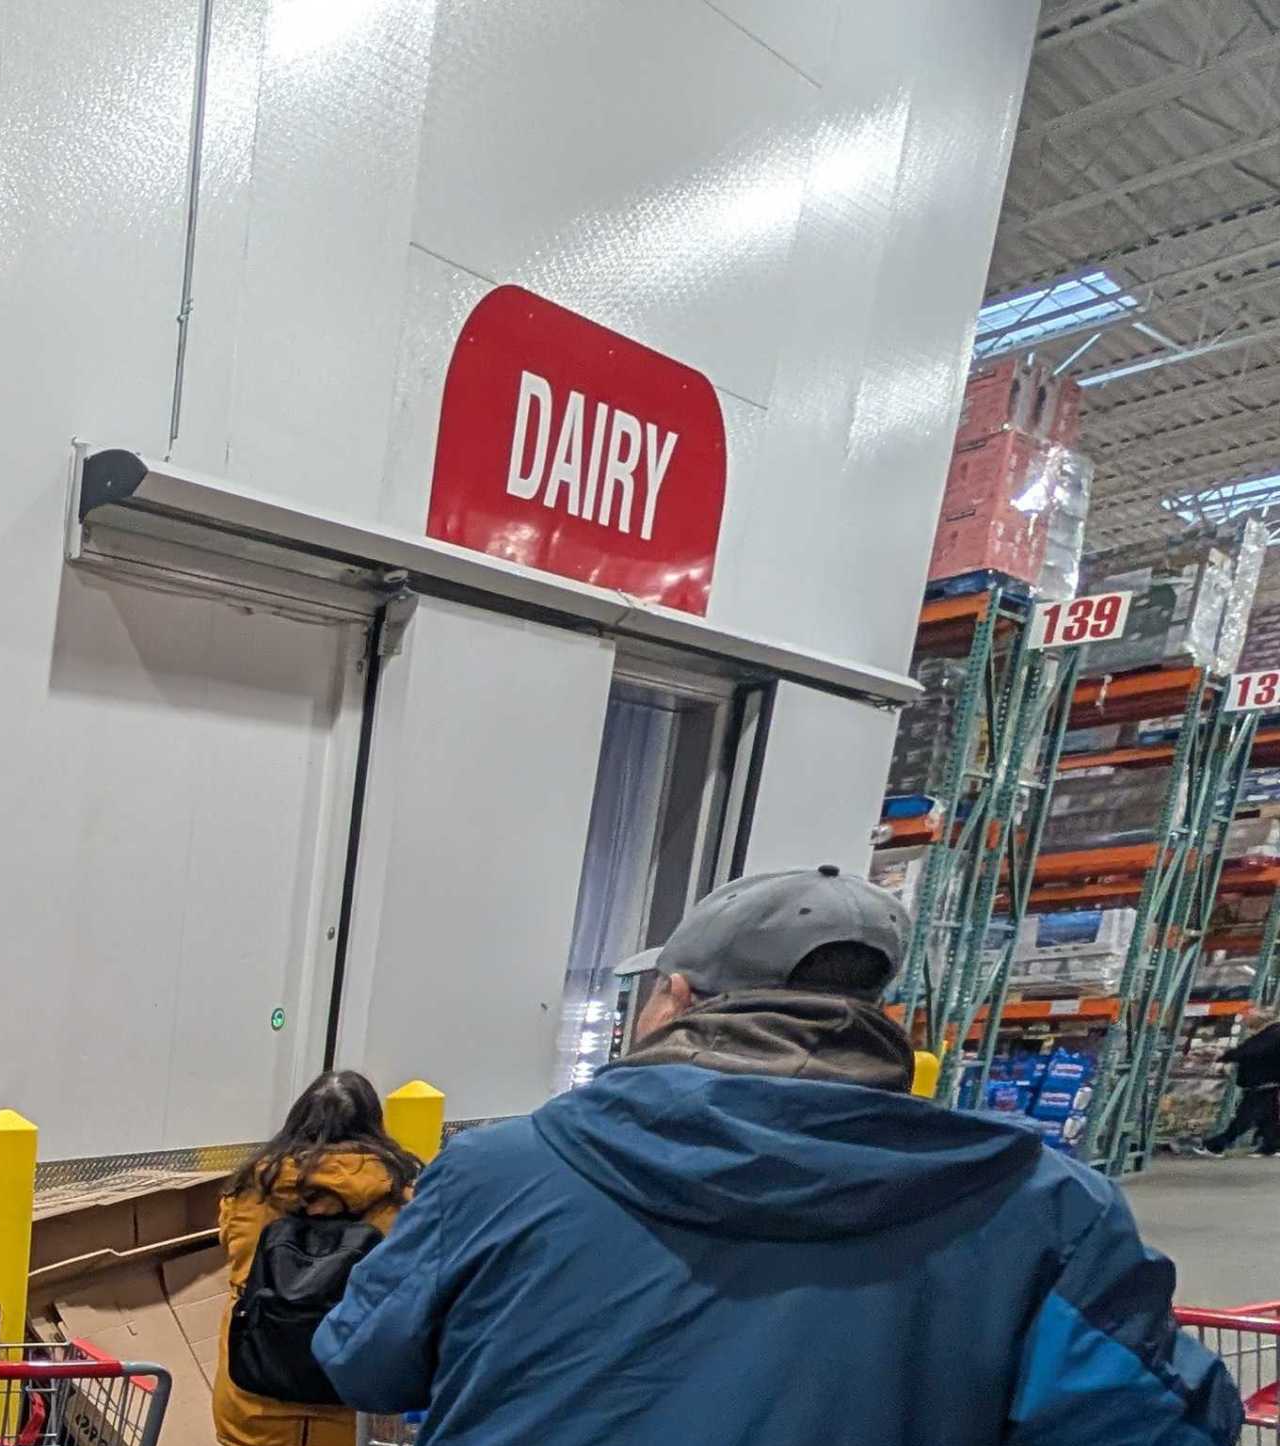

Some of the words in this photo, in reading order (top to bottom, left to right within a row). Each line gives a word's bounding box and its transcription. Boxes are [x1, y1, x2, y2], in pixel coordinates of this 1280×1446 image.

[506, 370, 679, 541] DAIRY
[1043, 595, 1123, 645] 139
[1237, 673, 1280, 707] 13
